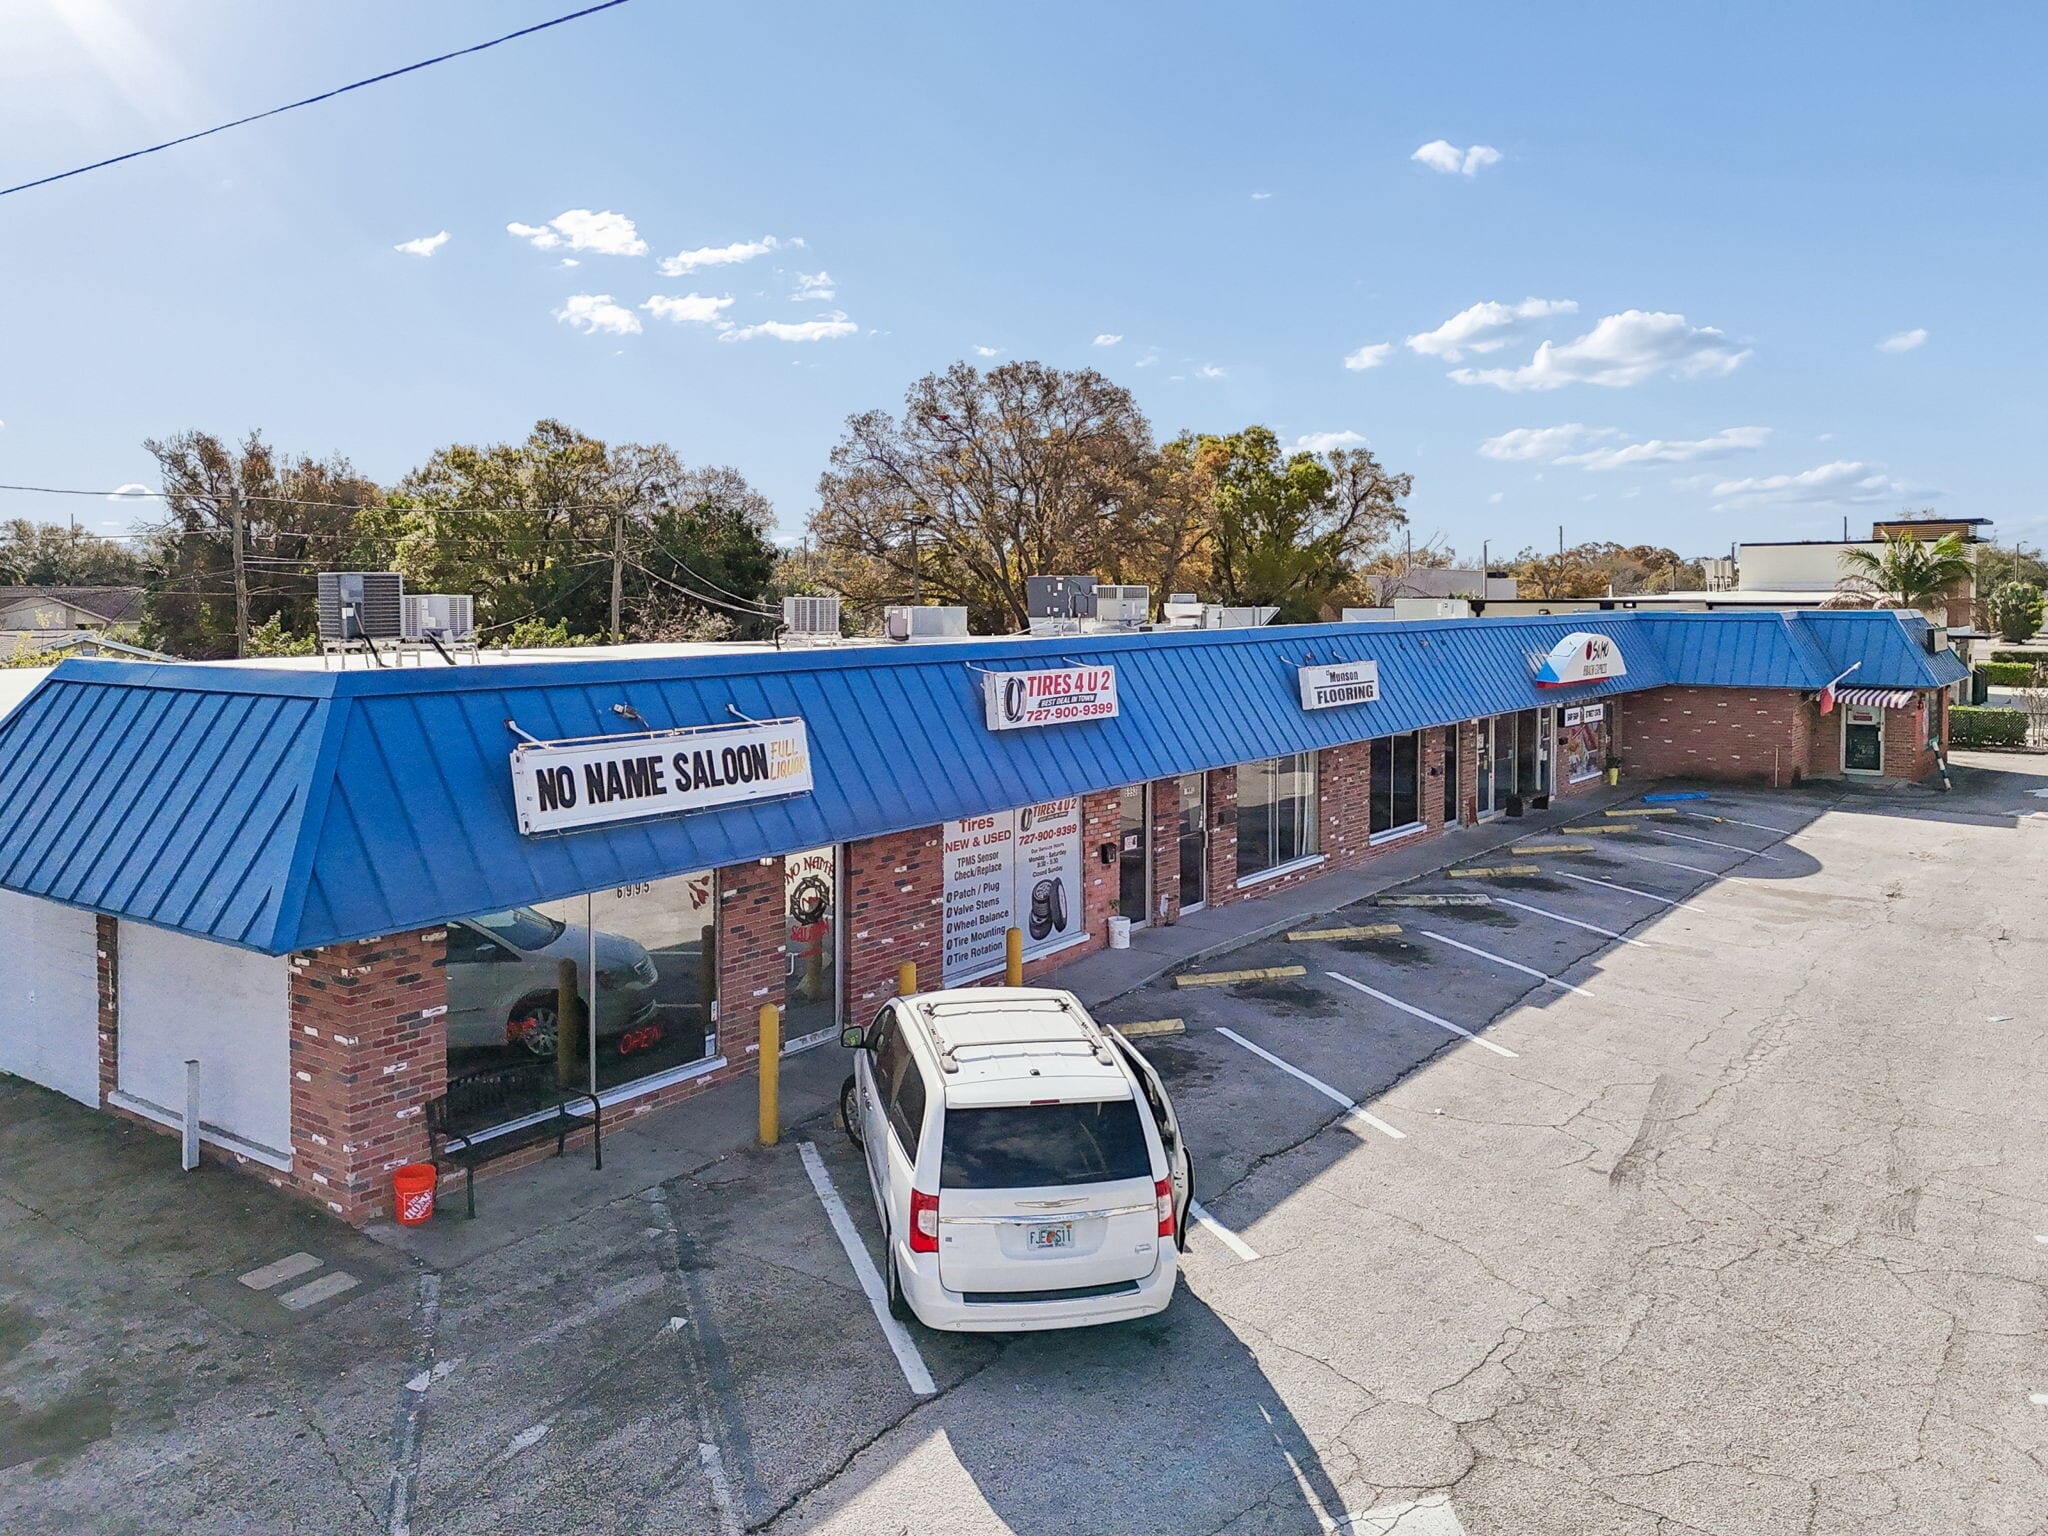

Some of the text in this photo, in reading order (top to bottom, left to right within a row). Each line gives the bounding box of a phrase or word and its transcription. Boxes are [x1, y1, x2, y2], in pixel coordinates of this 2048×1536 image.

[1027, 670, 1111, 697] TIRES 4 U 2
[1040, 698, 1055, 707] BEST
[1056, 697, 1070, 705] DEAL
[1078, 694, 1096, 703] TOWN
[1317, 684, 1374, 705] FLOORING
[1026, 702, 1113, 722] 727-900-9399
[771, 738, 799, 759] FULL
[536, 743, 769, 812] NO NAME SALOON
[770, 757, 807, 780] LIQUOR
[1033, 802, 1056, 817] TIRES
[1057, 801, 1063, 812] 4
[1064, 800, 1071, 811] U
[1071, 798, 1077, 809] 2
[959, 817, 995, 833] Tires
[1019, 823, 1077, 846] 727-900-9399
[945, 829, 1012, 853] NEW & USED
[957, 851, 999, 868] TPMS Sensor
[1028, 853, 1045, 863] Monday
[1049, 849, 1067, 861] Saturday
[785, 862, 800, 886] NO
[954, 863, 1002, 881] Check/Replace
[1032, 865, 1063, 878] Closed Sunday
[617, 882, 650, 899] 6995
[953, 881, 1000, 901] Patch / Plug
[953, 897, 1000, 916] Valve Stems
[953, 909, 1009, 932] Wheel Balance
[953, 925, 1006, 948] Tire Mounting
[953, 941, 1003, 964] Tire Rotation
